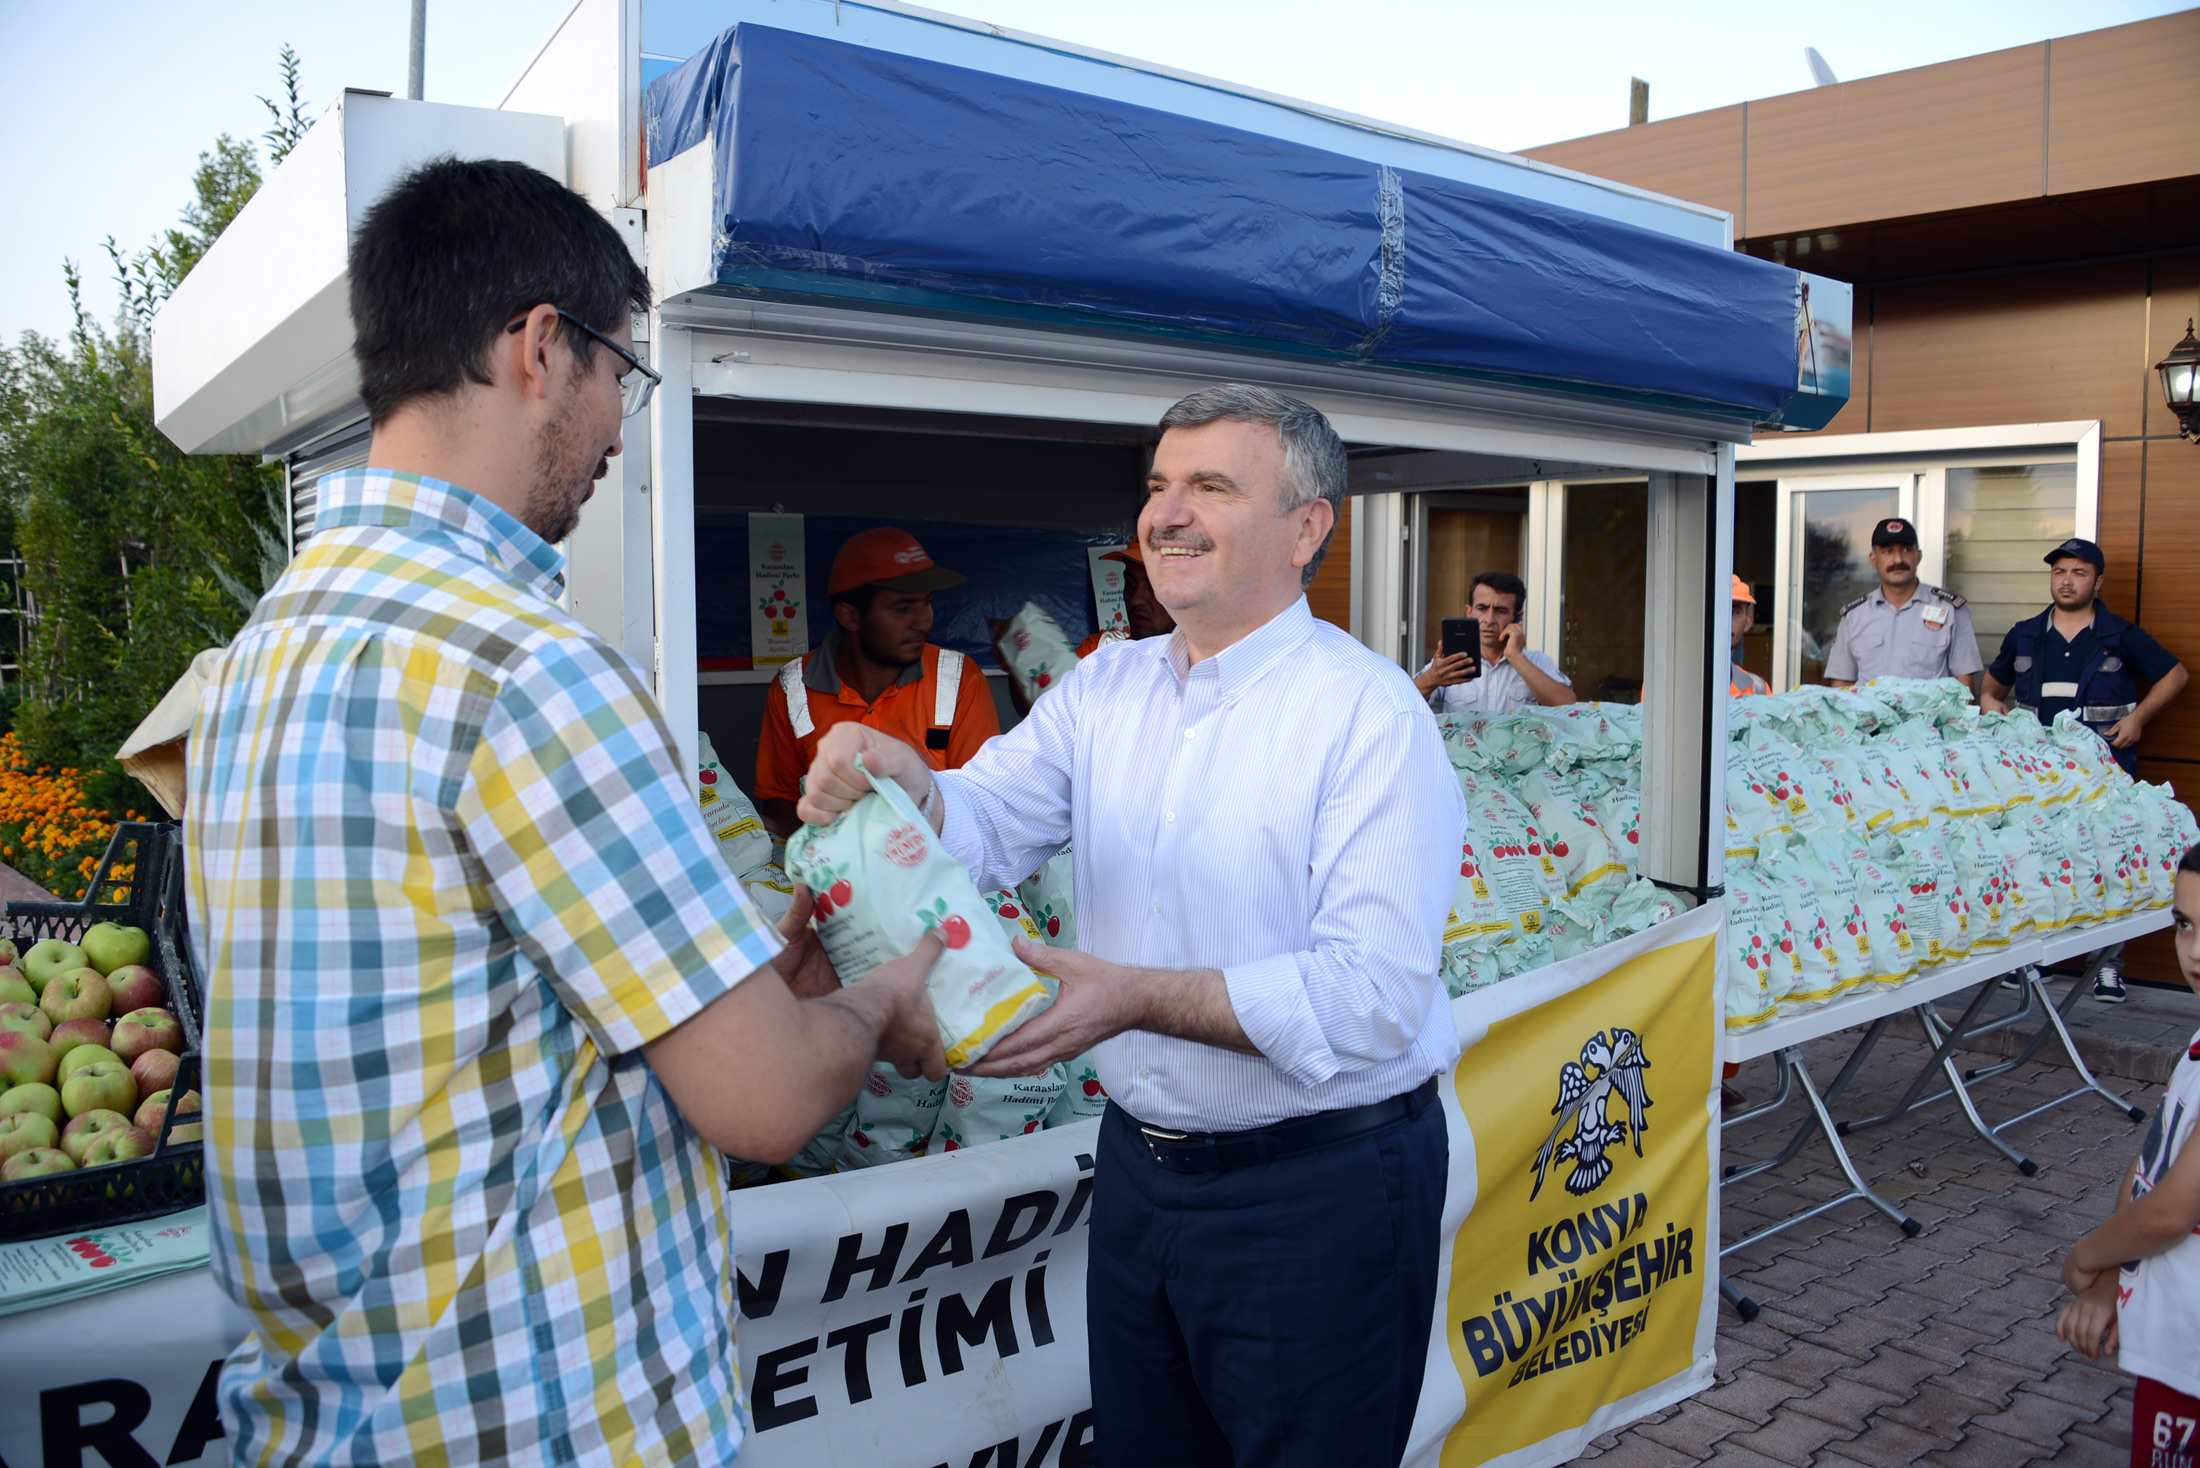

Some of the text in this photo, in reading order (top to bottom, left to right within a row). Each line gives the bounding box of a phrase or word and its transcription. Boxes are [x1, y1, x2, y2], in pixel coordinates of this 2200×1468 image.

[1001, 1094, 1044, 1105] Hadimi
[1013, 1082, 1066, 1094] Karaaslan
[820, 1153, 1095, 1304] HADİ
[1527, 1192, 1648, 1276] KONYA
[1461, 1222, 1694, 1378] BÜYÜKŞEHİR
[1507, 1298, 1652, 1389] BELEDİYESİ
[2153, 1411, 2196, 1452] 67
